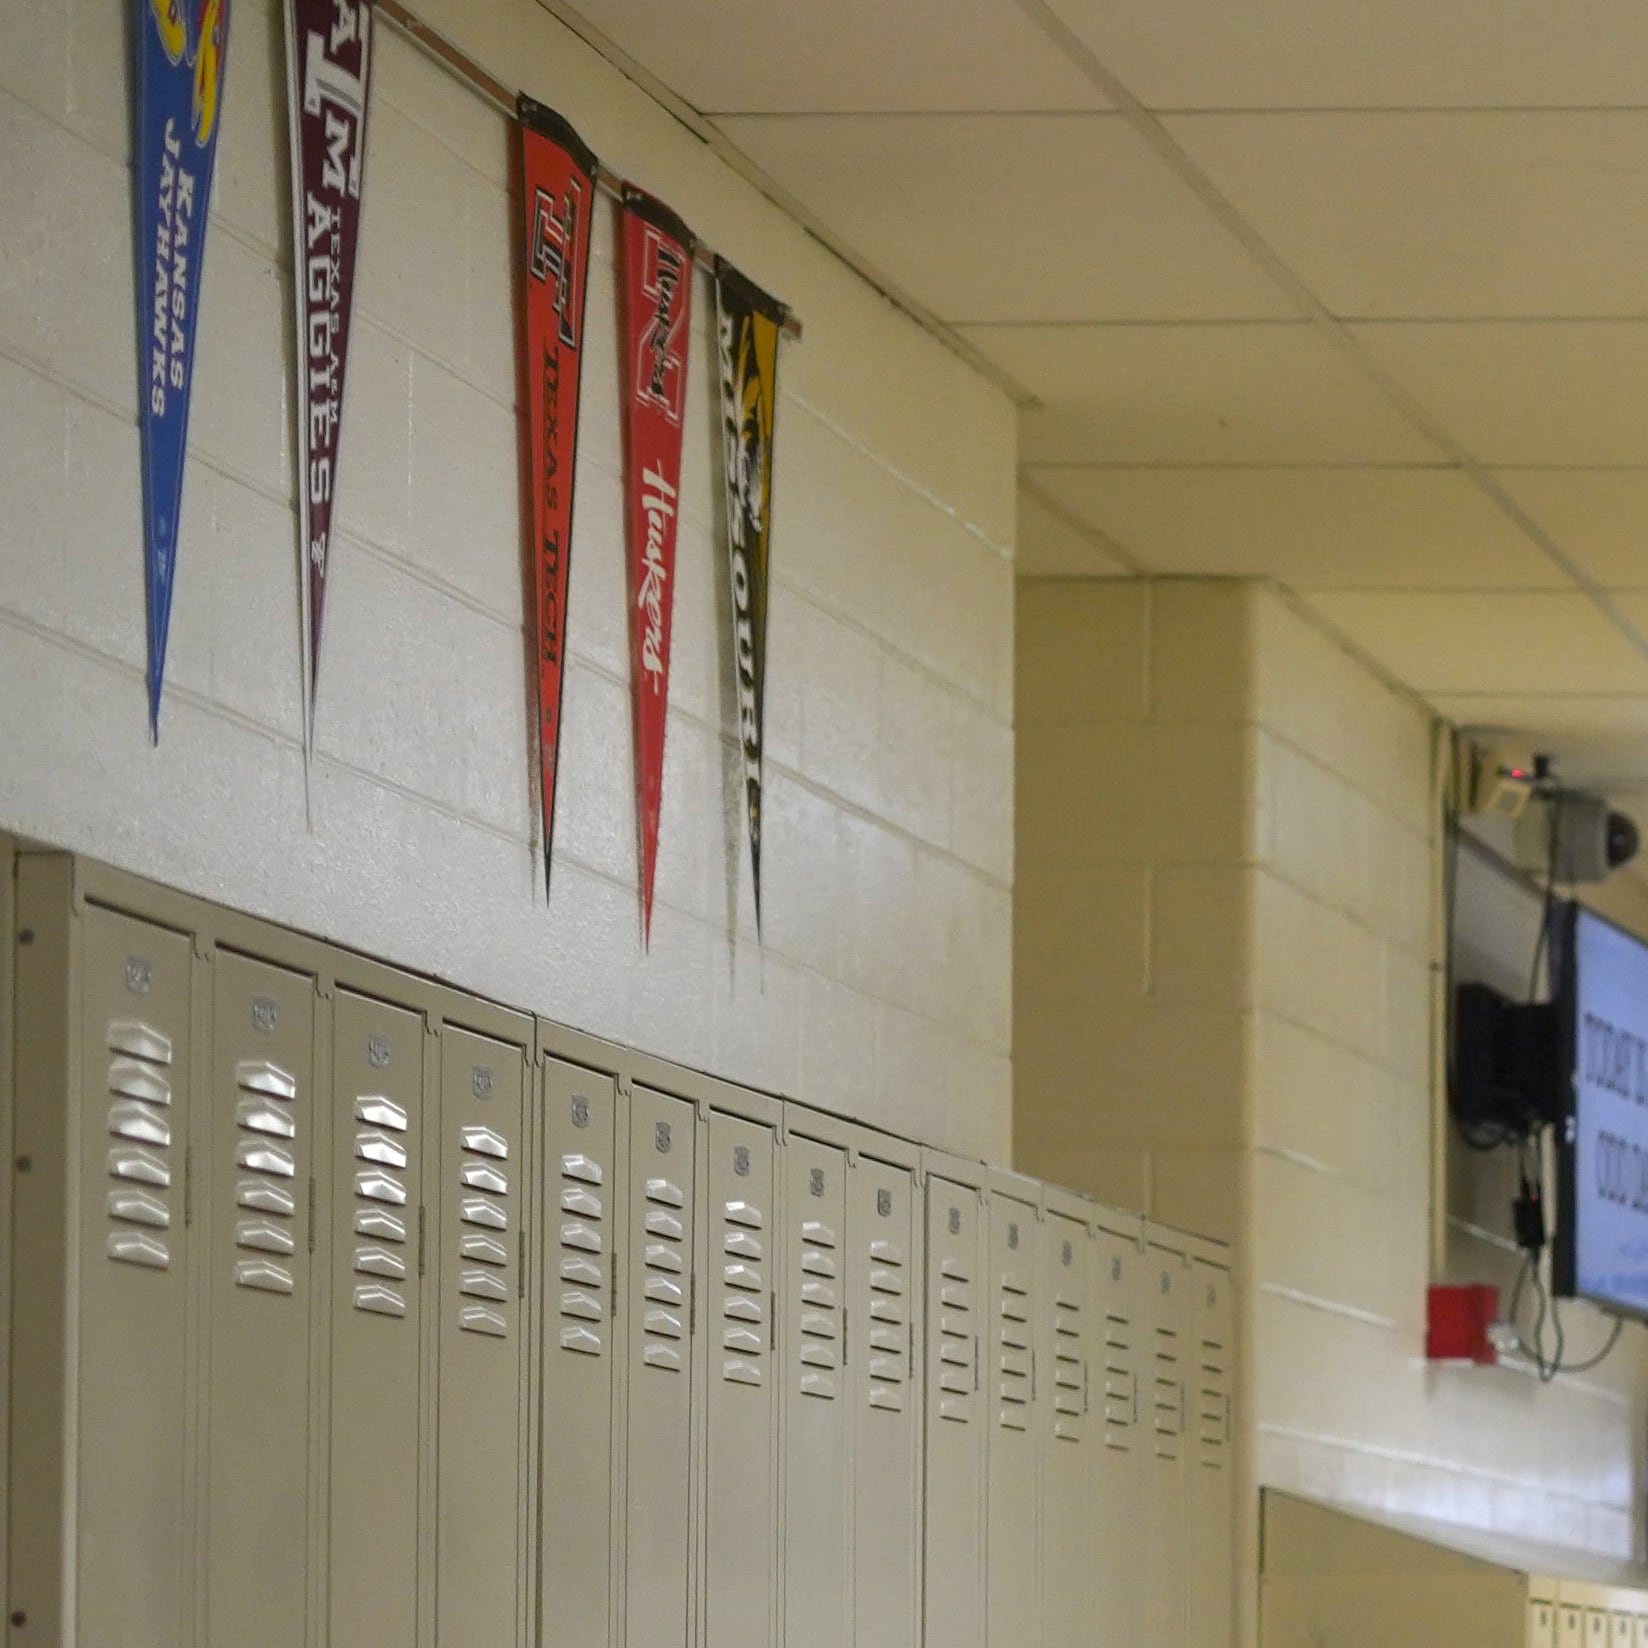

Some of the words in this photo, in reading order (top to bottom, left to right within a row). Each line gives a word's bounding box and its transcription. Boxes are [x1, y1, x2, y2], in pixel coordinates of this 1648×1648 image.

[151, 118, 181, 418] JAYHAWKS
[170, 169, 197, 391] KANSAS
[306, 190, 333, 505] AGGIES
[328, 206, 342, 335] TEXAS
[541, 343, 560, 511] TEXAS
[542, 531, 561, 666] TECH
[637, 458, 677, 696] Huskers
[716, 310, 762, 789] MISSOURI
